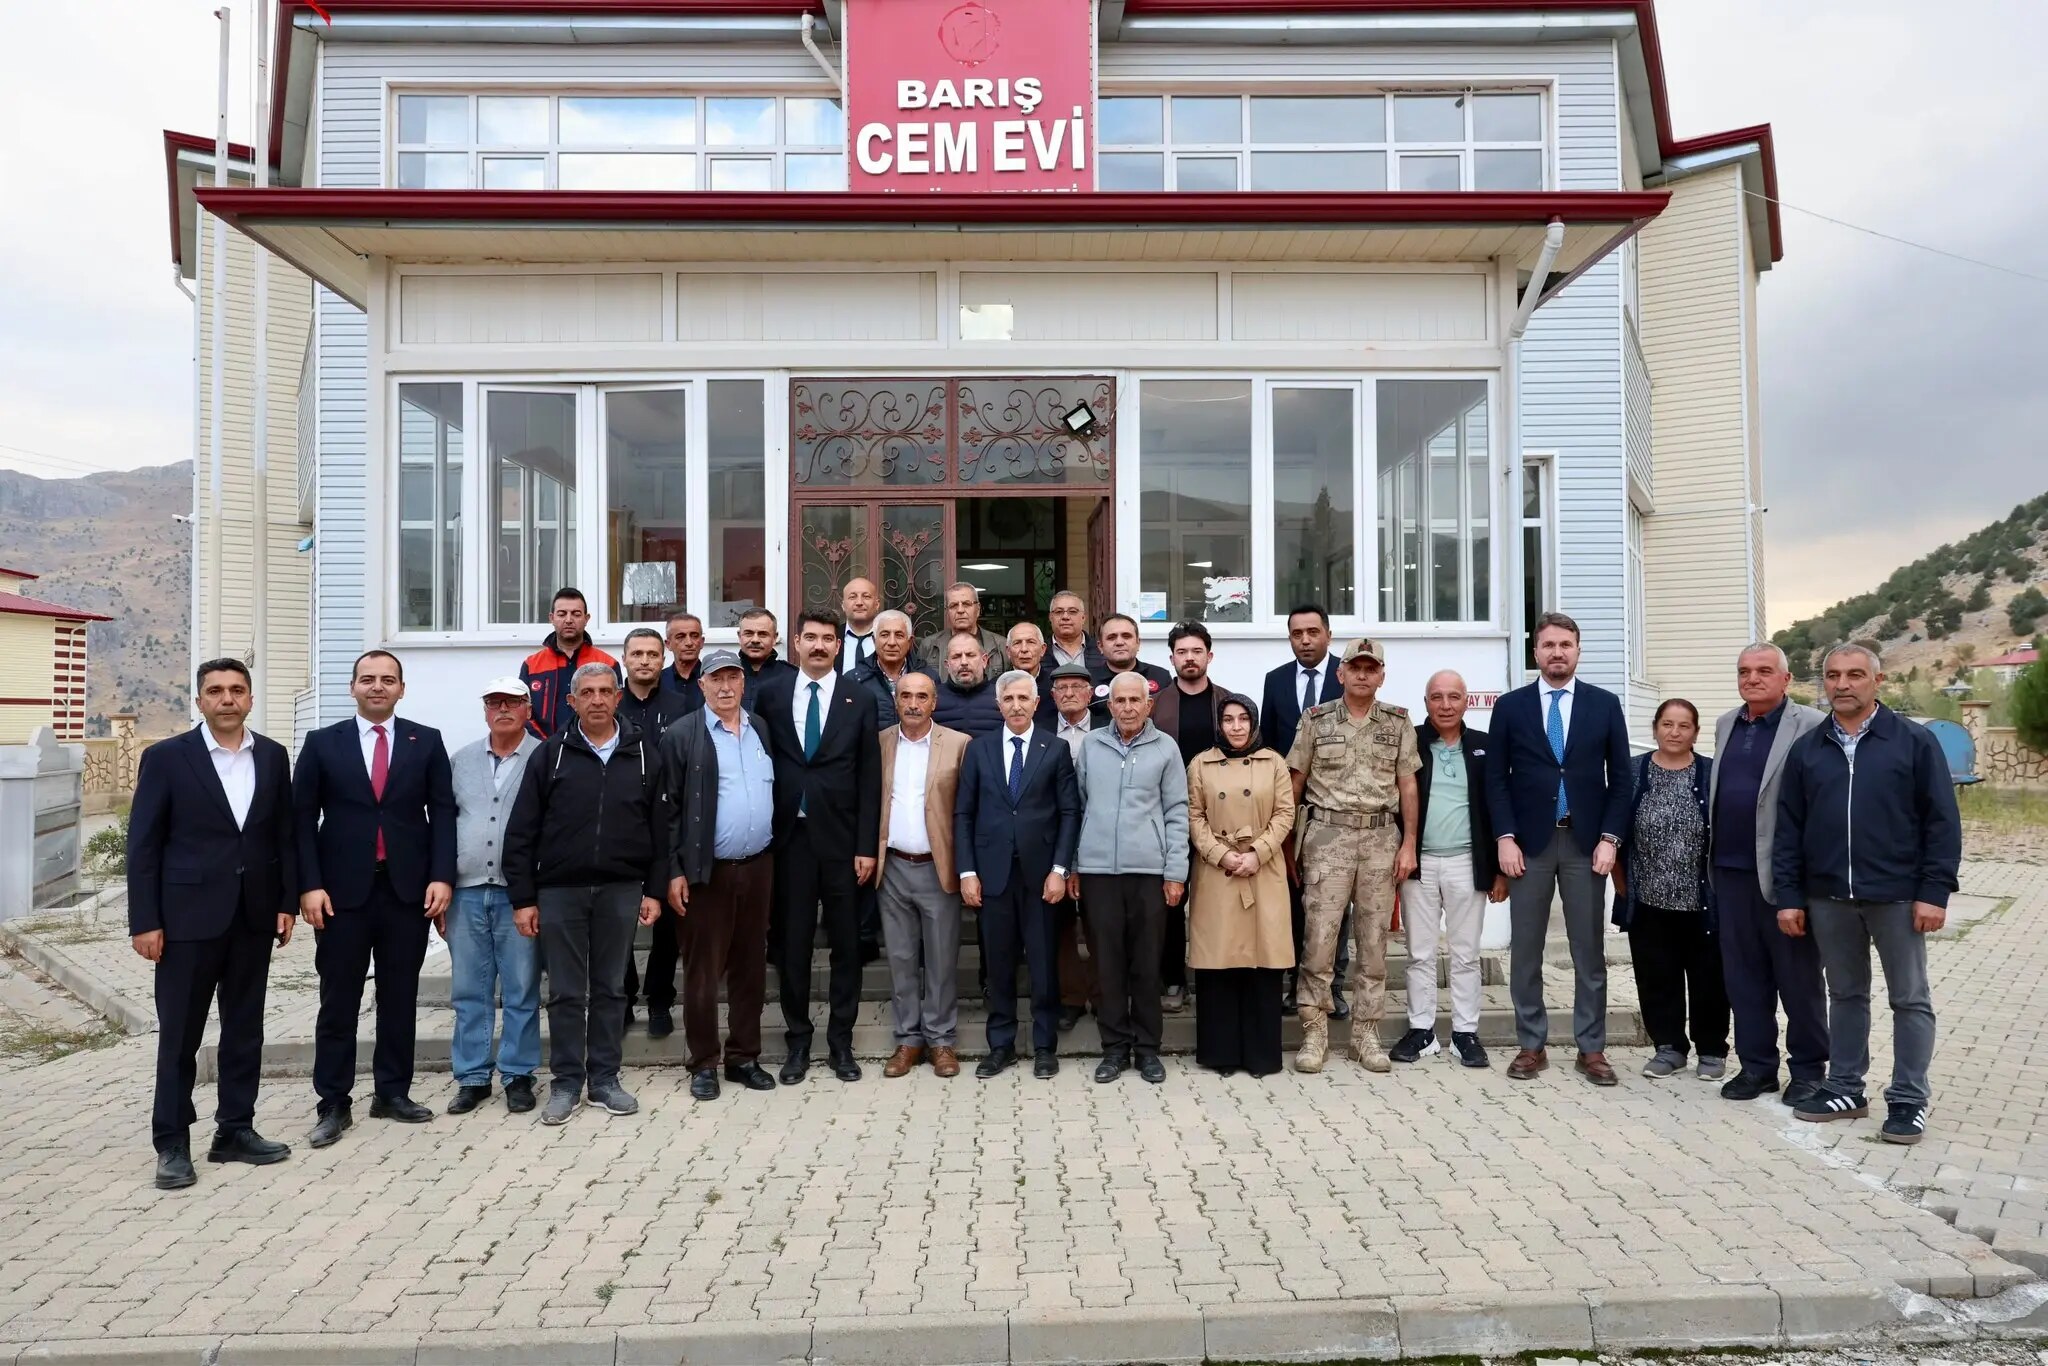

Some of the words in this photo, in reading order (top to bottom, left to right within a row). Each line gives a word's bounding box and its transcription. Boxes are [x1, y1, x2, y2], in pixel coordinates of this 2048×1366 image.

[897, 77, 1043, 115] BARIŞ
[856, 121, 978, 175] CEM
[993, 105, 1085, 172] EVİ
